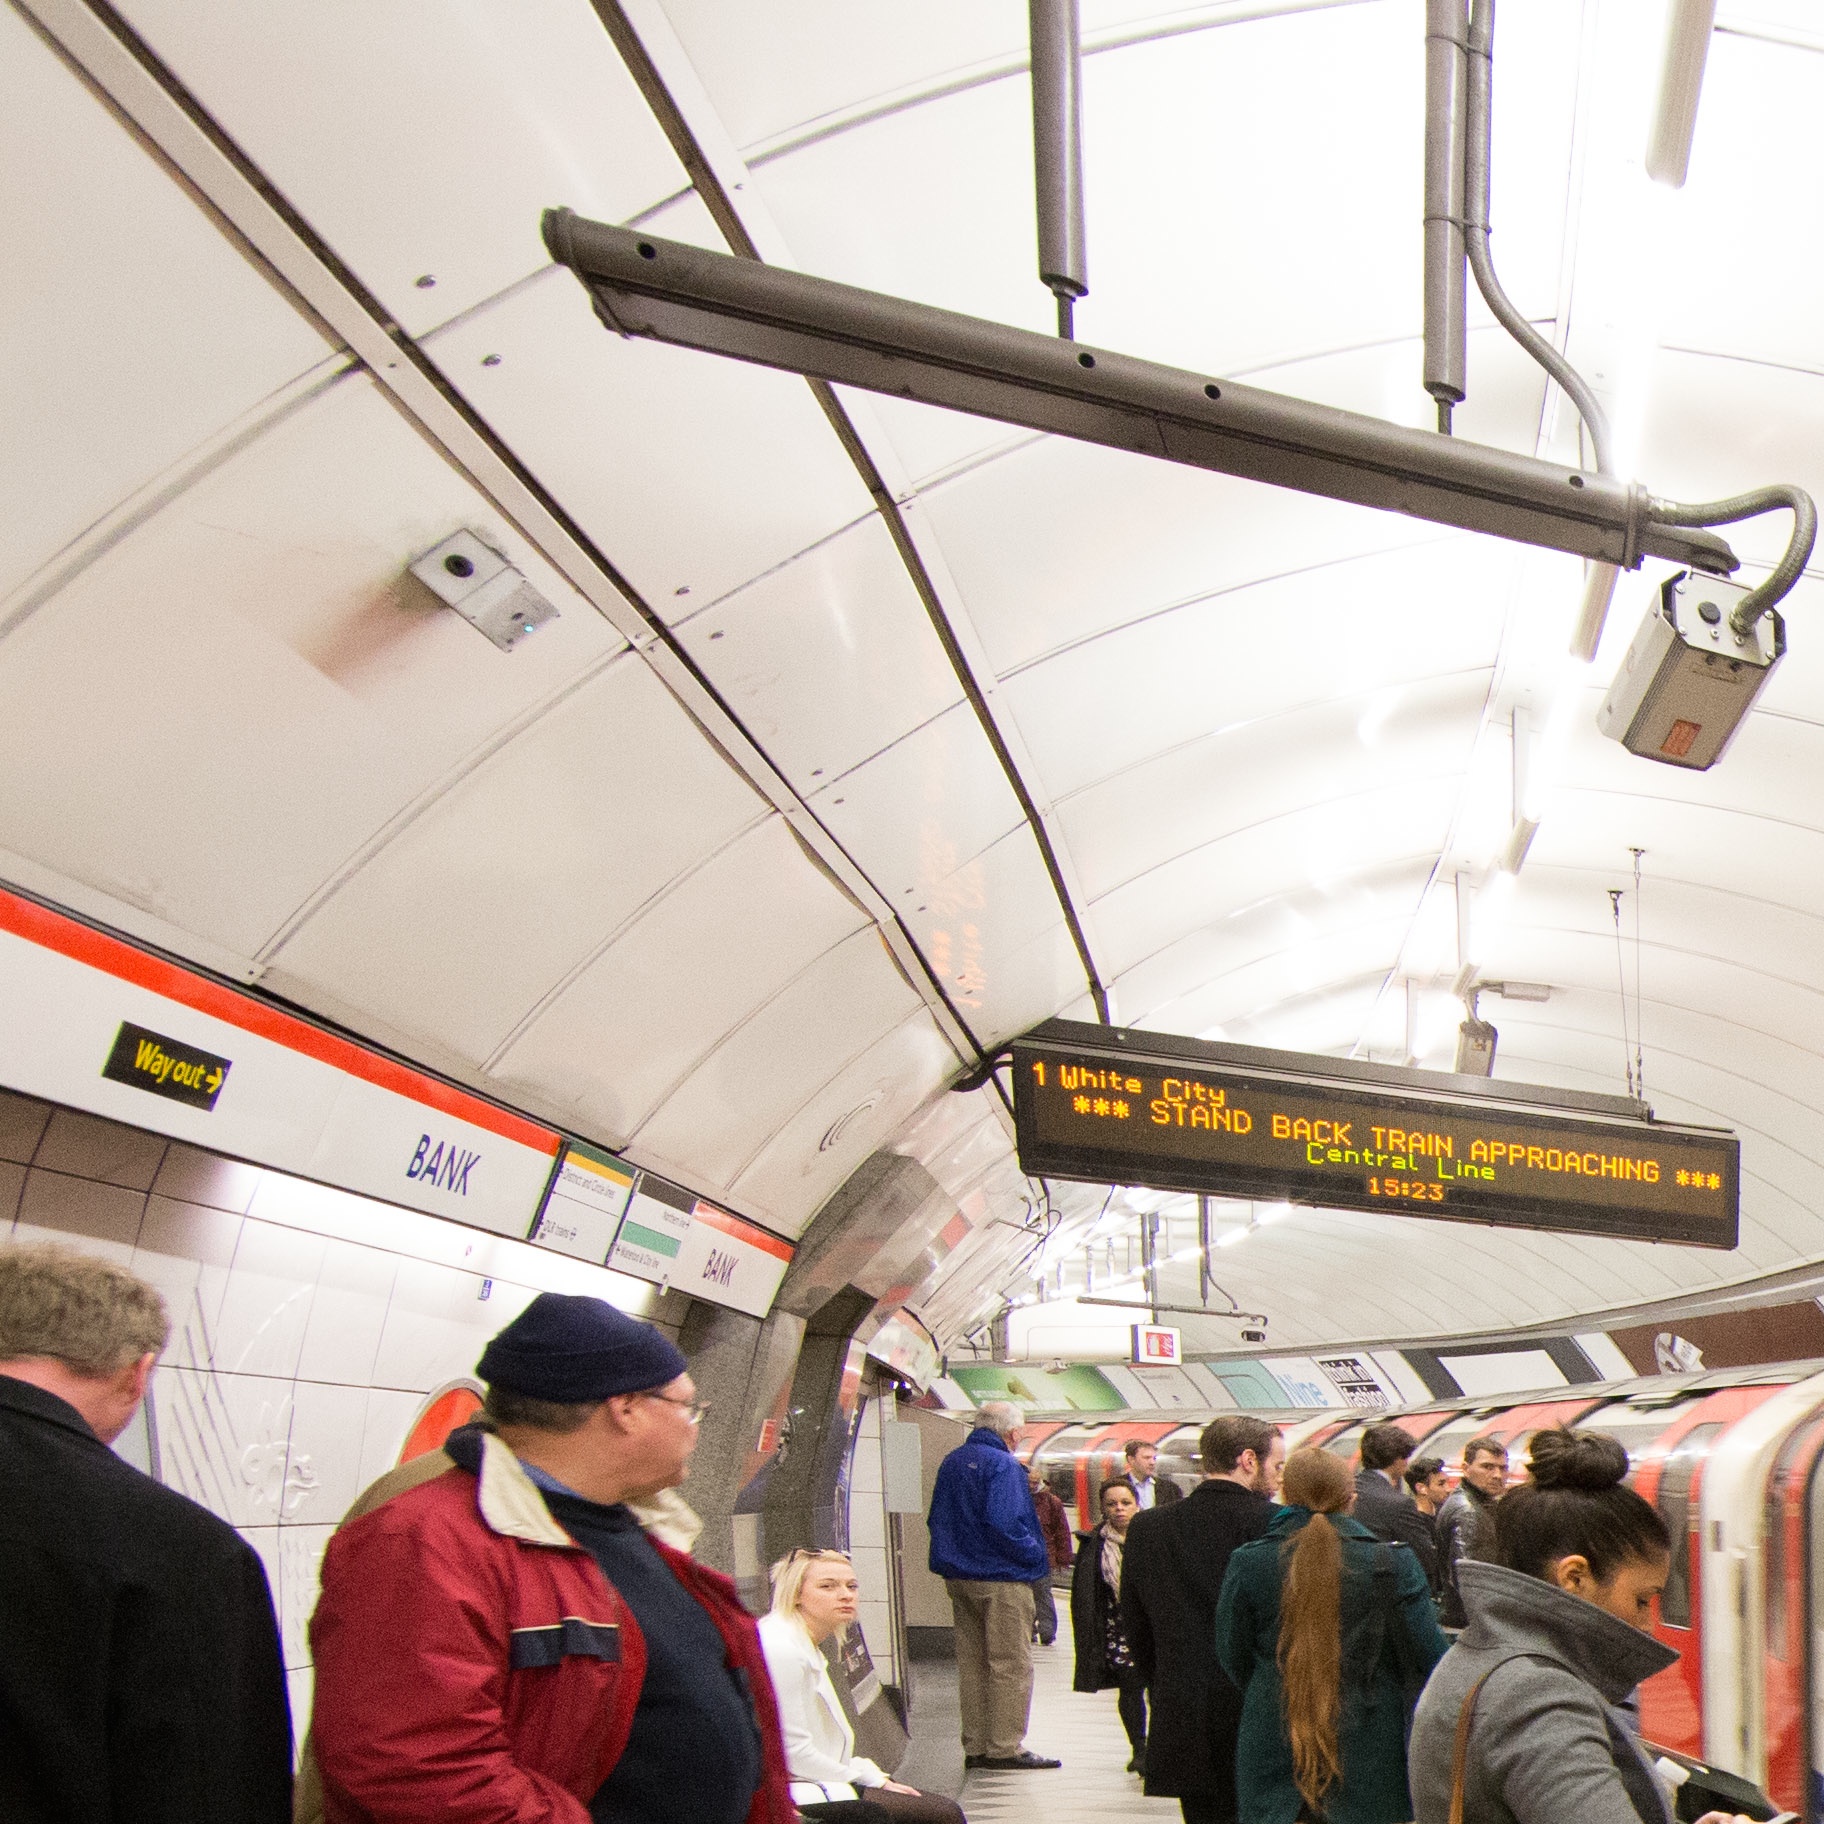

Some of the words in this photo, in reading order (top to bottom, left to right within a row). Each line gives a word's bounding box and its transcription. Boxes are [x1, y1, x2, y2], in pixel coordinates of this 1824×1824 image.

[134, 1039, 176, 1084] Way
[172, 1060, 206, 1090] out
[1032, 1061, 1046, 1087] 1
[1060, 1065, 1142, 1094] White
[1162, 1078, 1225, 1108] City
[1150, 1100, 1252, 1134] STAND
[1272, 1113, 1352, 1147] BACK
[1370, 1125, 1453, 1159] TRAIN
[1470, 1139, 1661, 1183] APPROACHING
[1306, 1142, 1418, 1173] Central
[1437, 1156, 1495, 1182] Line
[405, 1134, 482, 1197] BANK
[1368, 1175, 1445, 1202] 15:23
[702, 1248, 740, 1288] BANK
